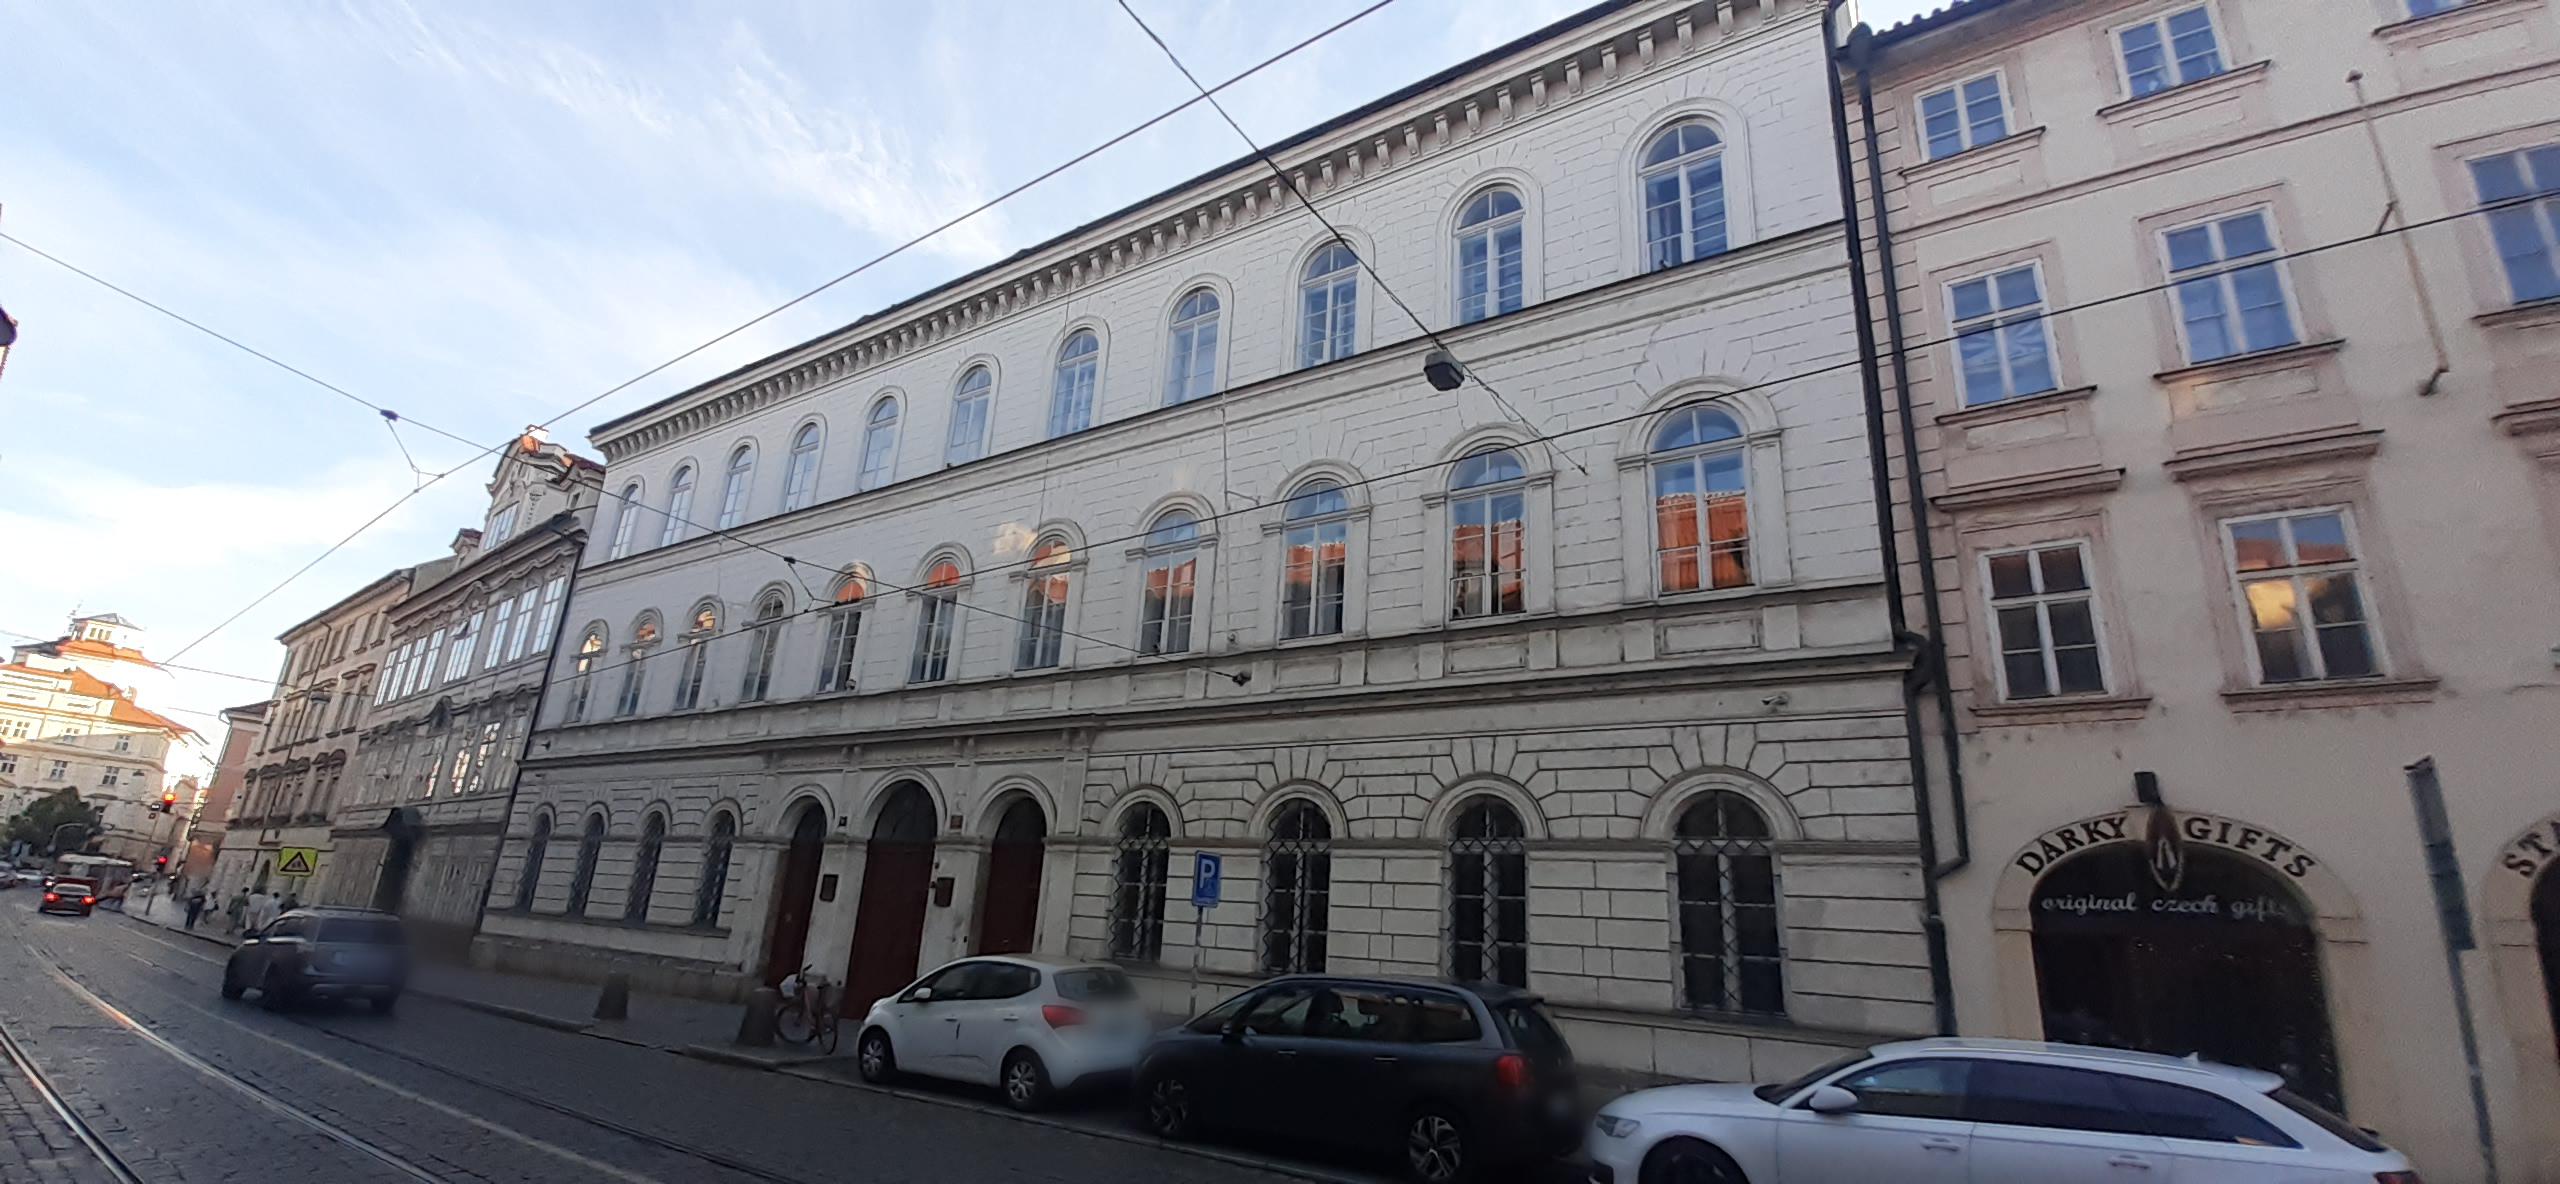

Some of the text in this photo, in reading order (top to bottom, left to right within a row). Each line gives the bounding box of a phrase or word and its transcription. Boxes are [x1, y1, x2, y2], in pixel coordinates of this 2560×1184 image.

[2184, 817, 2316, 877] GIFTS
[1200, 858, 1216, 889] P
[2041, 892, 2138, 915] original
[2152, 894, 2219, 914] czech
